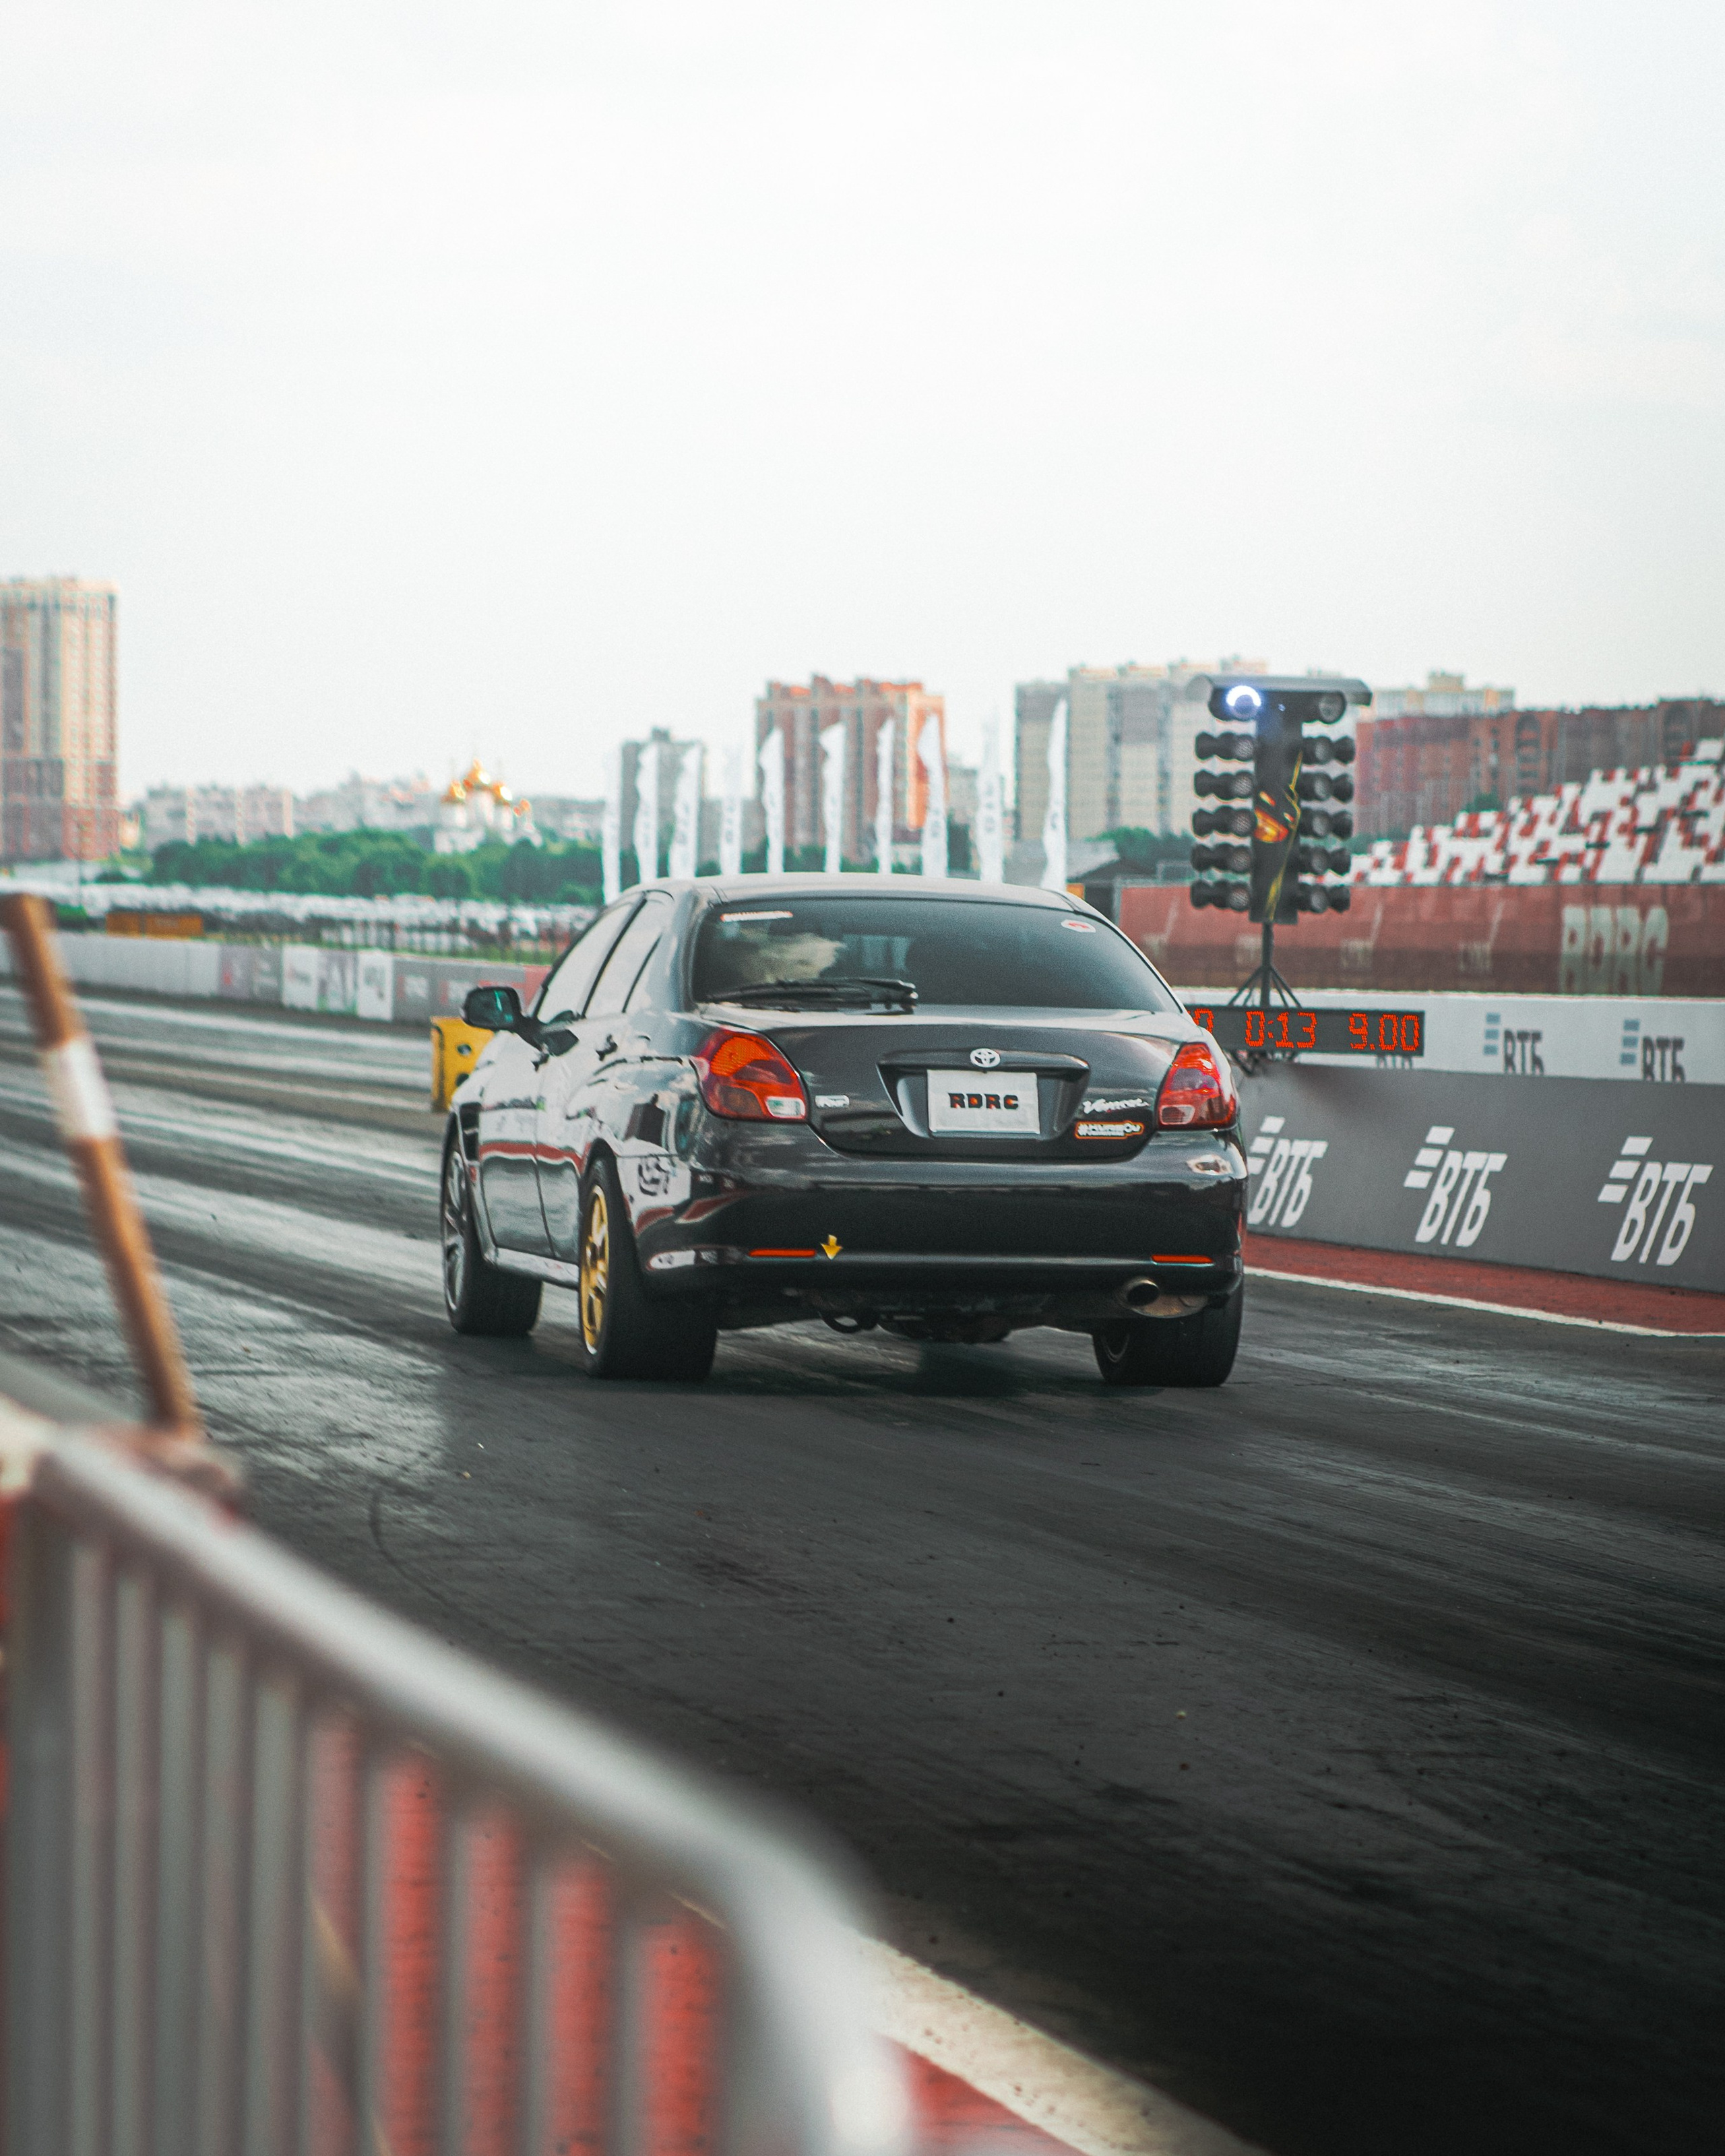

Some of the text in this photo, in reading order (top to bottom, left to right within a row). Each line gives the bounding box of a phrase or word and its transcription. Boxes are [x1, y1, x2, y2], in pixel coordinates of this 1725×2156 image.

[1245, 1011, 1317, 1048] 0:13
[1349, 1013, 1420, 1051] 9.00
[947, 1093, 1019, 1110] RDRC
[1247, 1139, 1328, 1228] ВТБ
[1415, 1150, 1508, 1247] ВТБ
[1610, 1162, 1714, 1267] ВТБ
